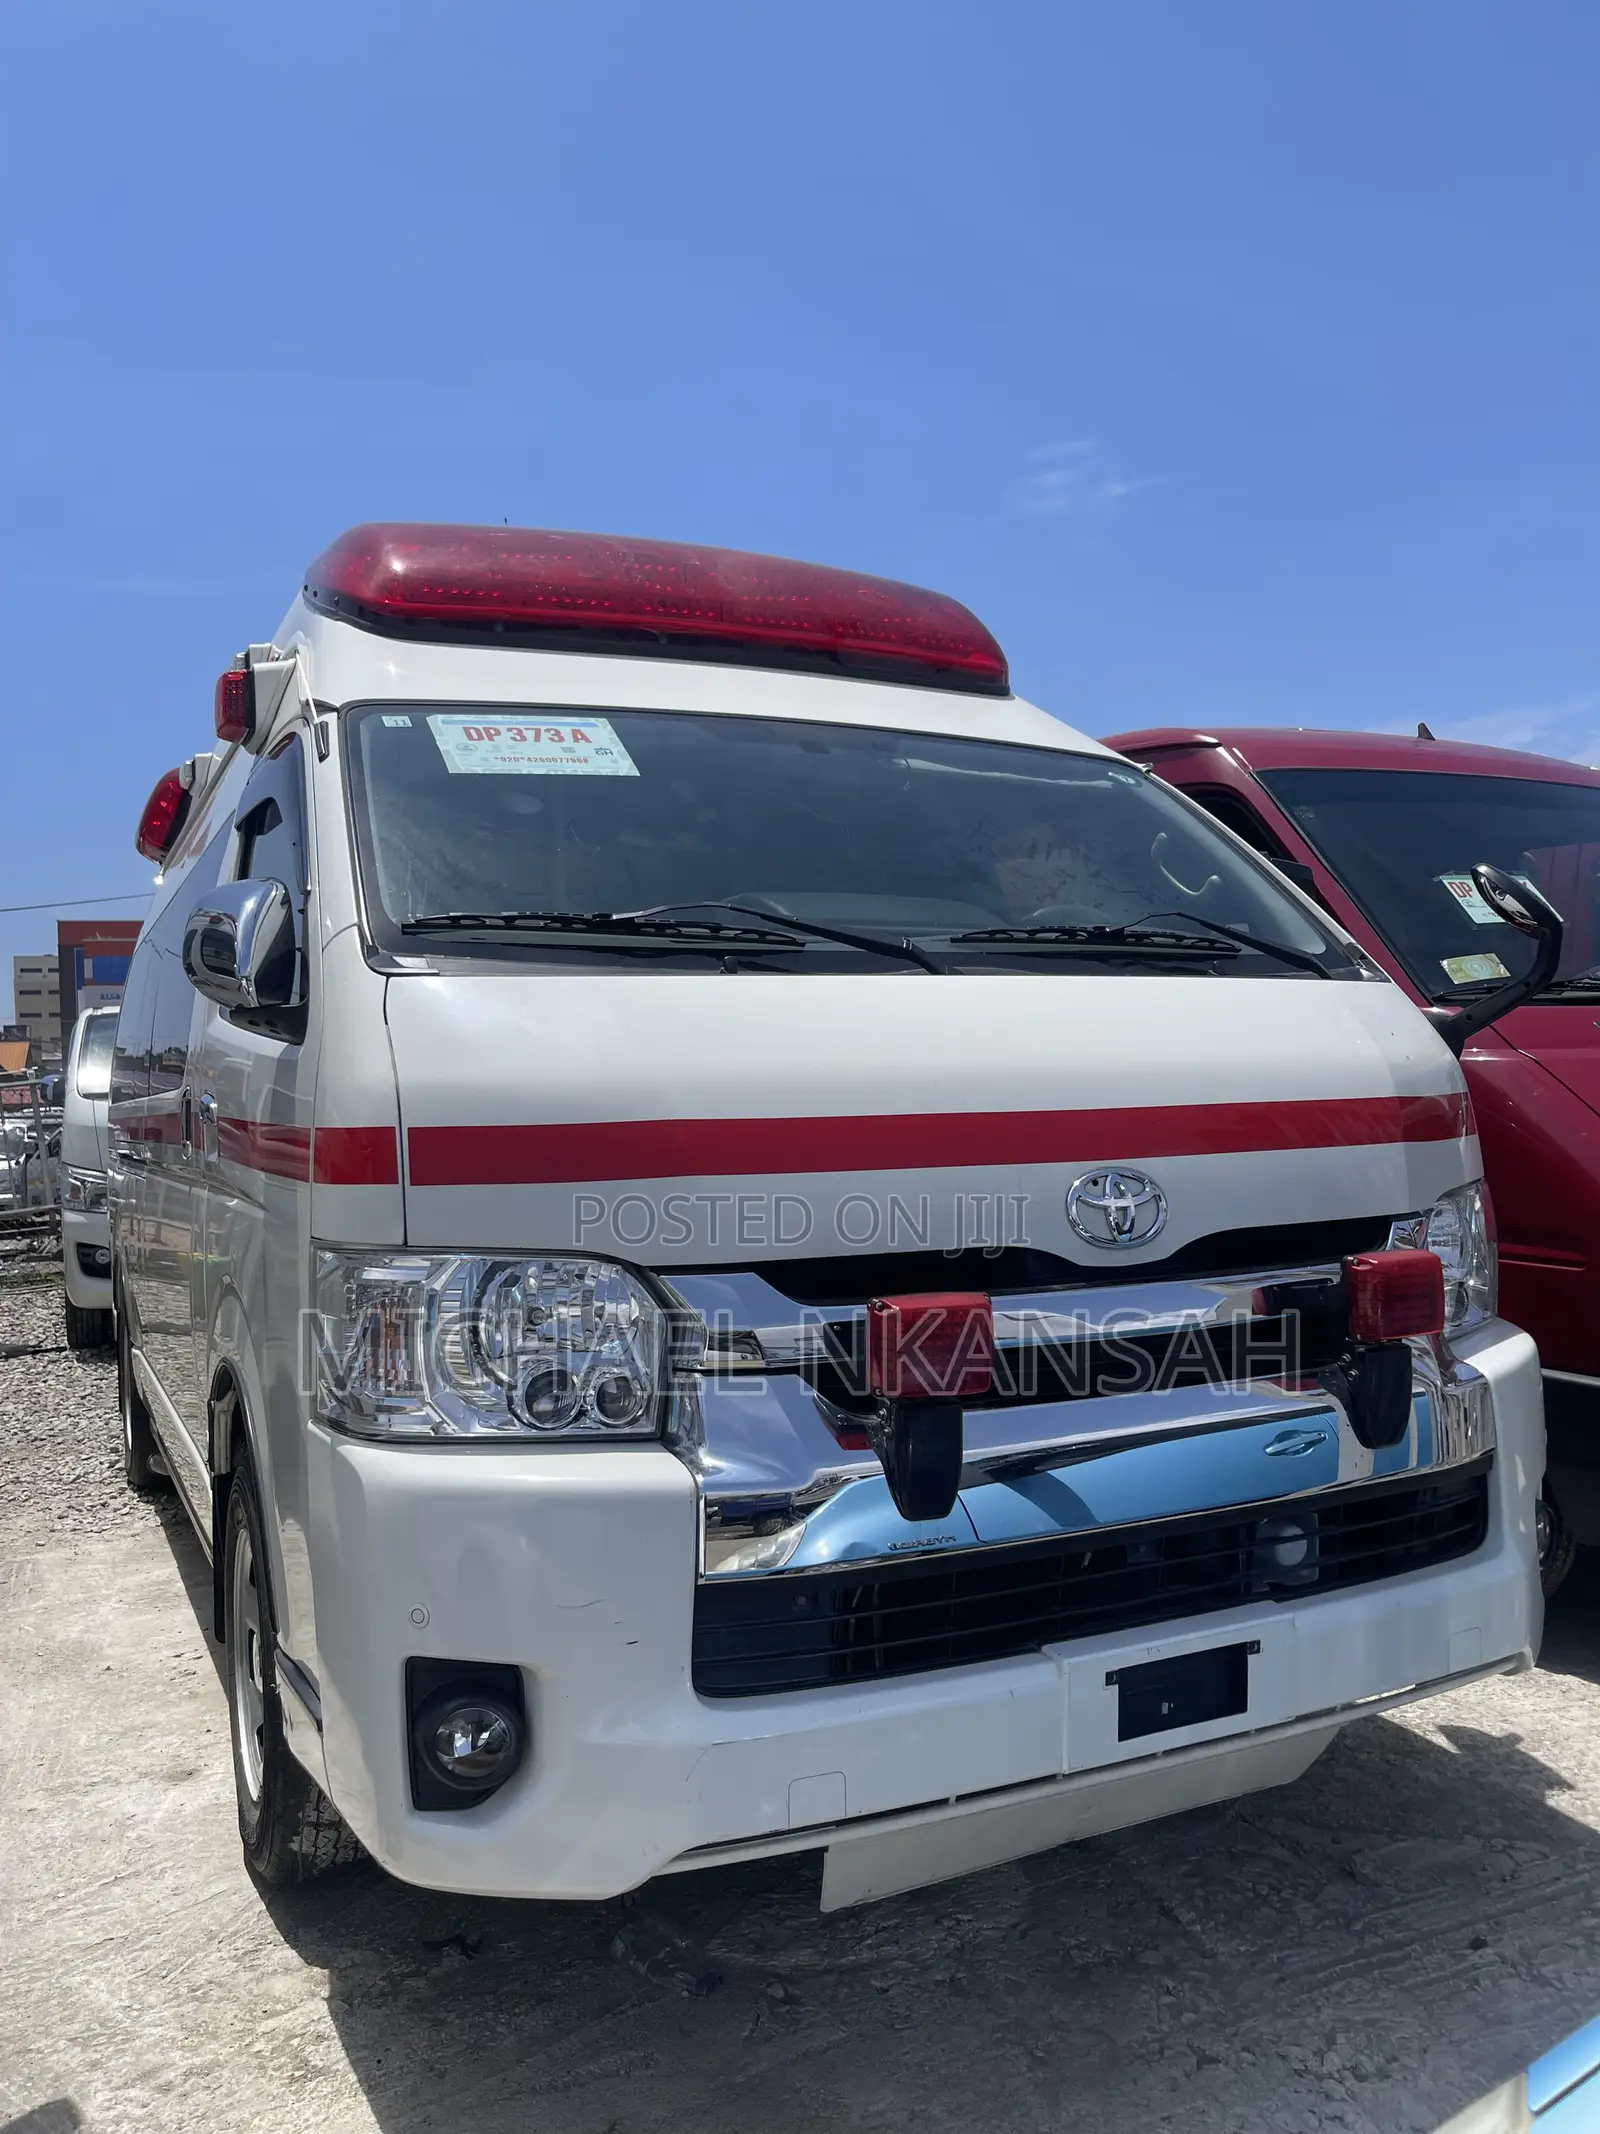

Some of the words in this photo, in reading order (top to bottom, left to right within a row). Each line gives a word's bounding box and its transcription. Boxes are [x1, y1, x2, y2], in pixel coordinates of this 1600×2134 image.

[462, 726, 502, 742] DP
[506, 727, 566, 743] 373
[571, 728, 593, 744] A
[1448, 881, 1474, 899] DP
